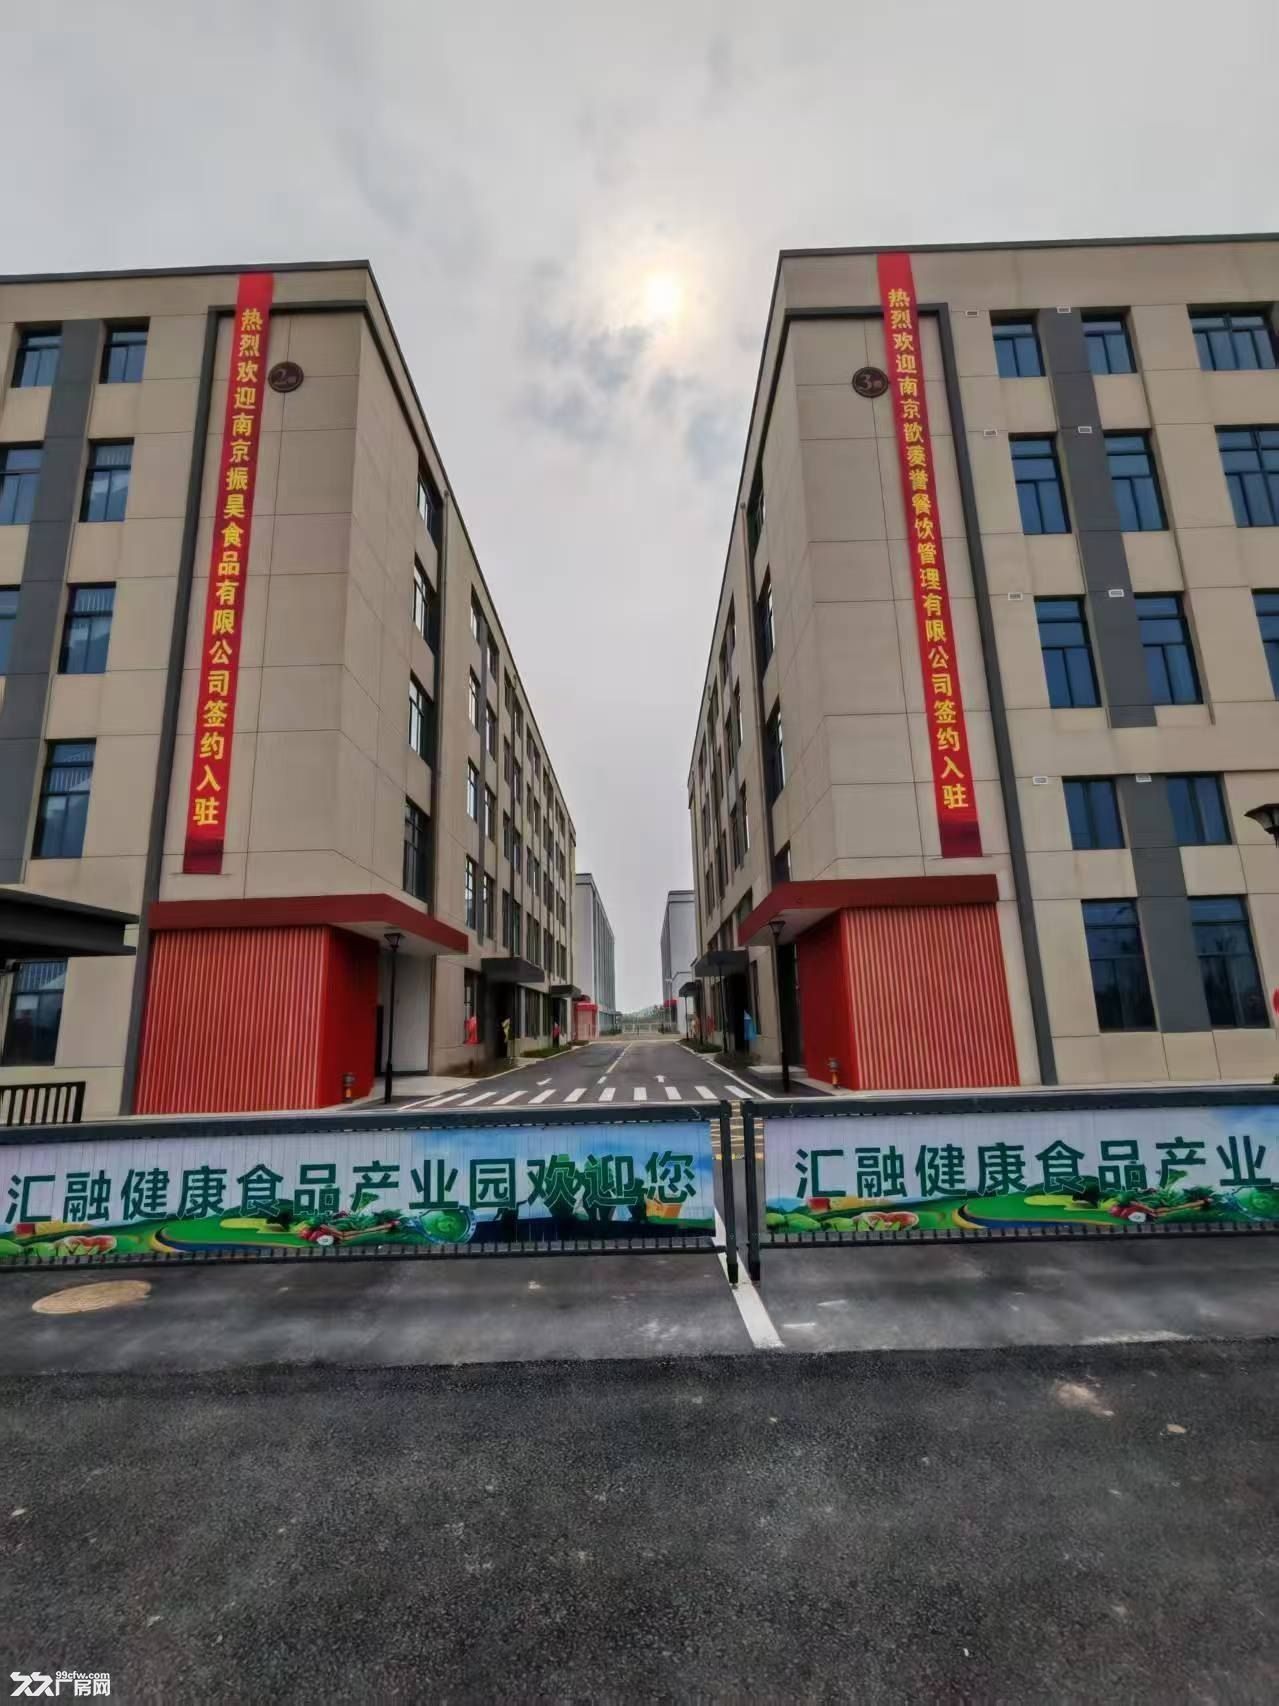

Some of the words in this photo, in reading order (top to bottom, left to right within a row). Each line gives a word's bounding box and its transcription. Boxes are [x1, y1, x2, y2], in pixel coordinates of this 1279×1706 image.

[193, 308, 263, 826] 热烈欢迎南京振昊食品有限公司签约入驻
[5, 1151, 696, 1225] 汇融健康食品产业园欢迎您
[793, 1135, 1273, 1200] 汇融健康食品产业
